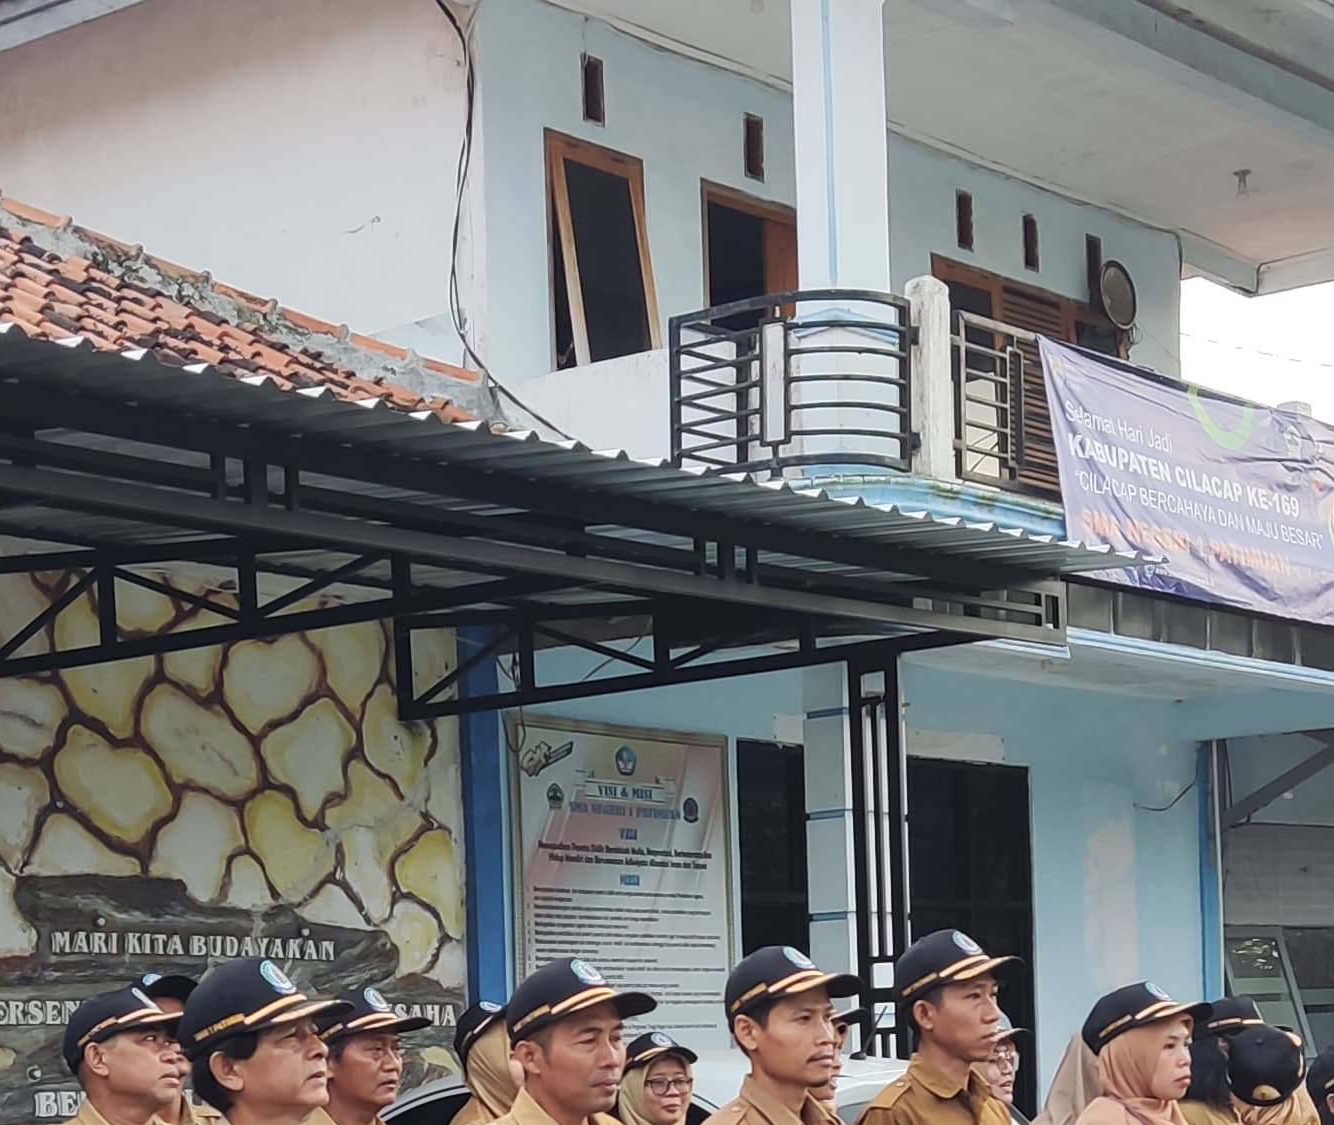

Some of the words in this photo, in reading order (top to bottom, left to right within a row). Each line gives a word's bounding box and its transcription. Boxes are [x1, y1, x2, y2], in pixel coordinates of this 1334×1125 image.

[1065, 399, 1116, 435] Selamat
[1117, 418, 1144, 445] Hari
[1147, 427, 1173, 454] Jadi
[1067, 433, 1172, 483] KABUPATEN
[1174, 466, 1243, 503] CILACAP
[1246, 485, 1300, 518] KE-169
[1139, 487, 1217, 525] BERCAHAYA
[1218, 508, 1245, 533] DAN
[1246, 515, 1279, 540] MAJU
[597, 785, 617, 797] VISI
[620, 786, 628, 798] &
[632, 788, 653, 801] MISI
[51, 931, 118, 955] MARI
[124, 933, 185, 956] KITA
[189, 935, 336, 961] BUDAYAKAN
[388, 1003, 457, 1026] SAHA
